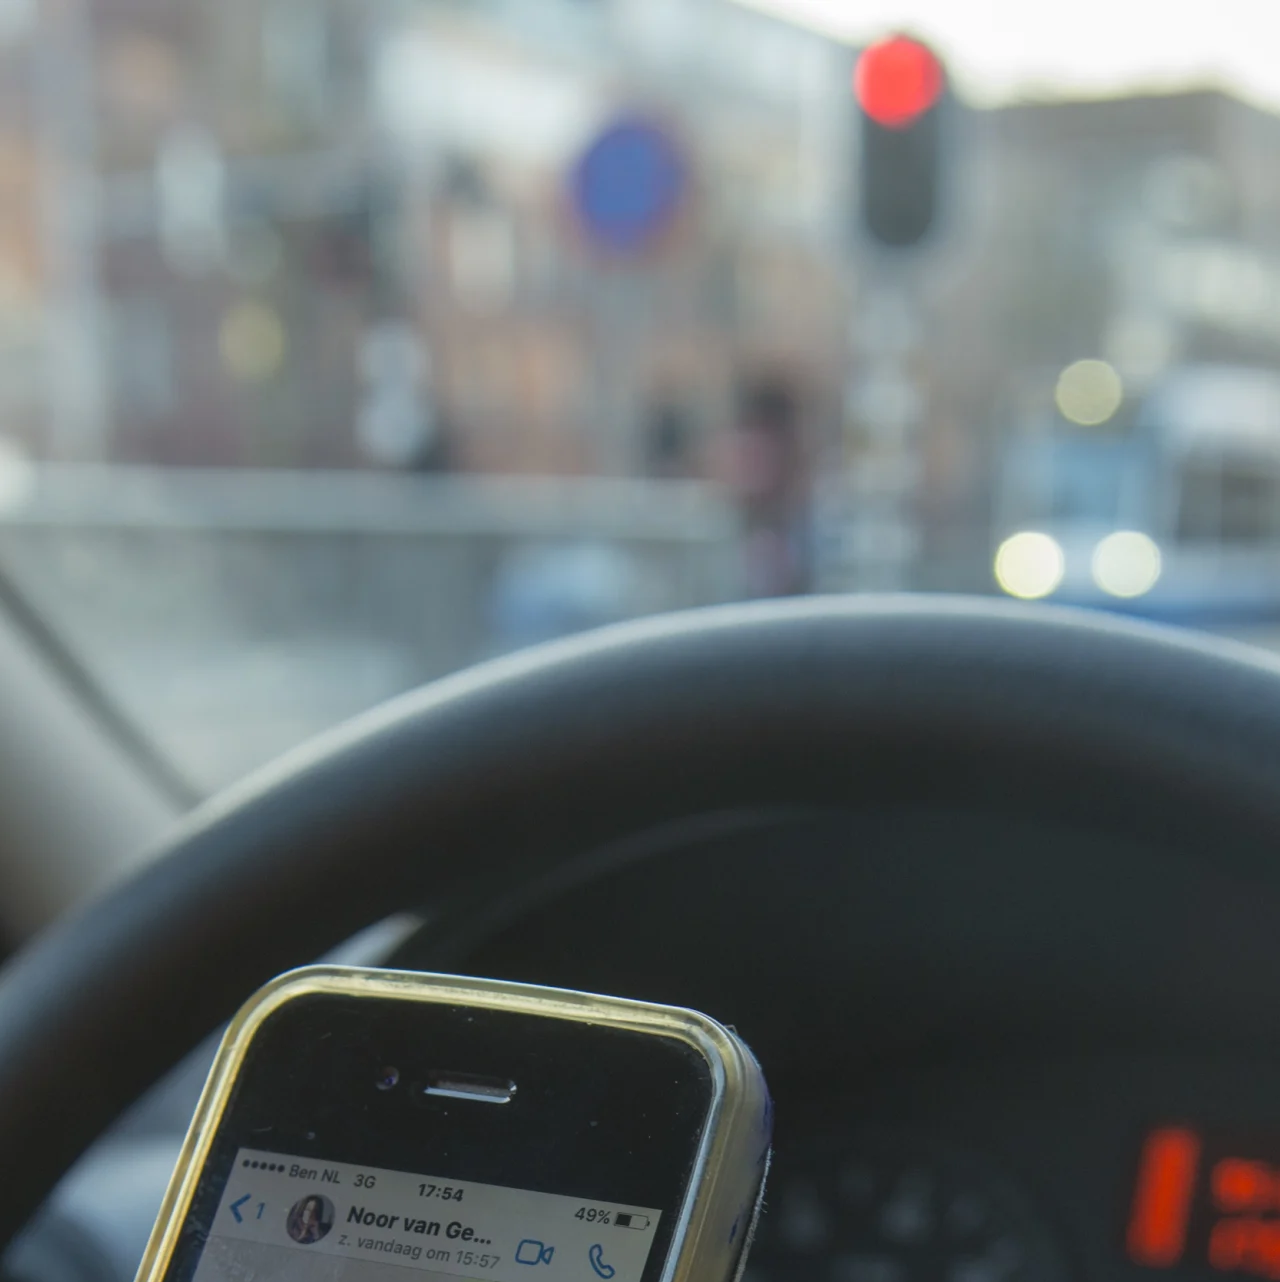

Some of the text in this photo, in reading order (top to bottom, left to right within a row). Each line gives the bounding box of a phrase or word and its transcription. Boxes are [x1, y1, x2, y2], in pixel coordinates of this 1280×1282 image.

[288, 1164, 377, 1189] Ben NL 3G
[417, 1183, 465, 1202] 17:54
[255, 1202, 266, 1220] 1
[346, 1205, 400, 1230] Noor
[404, 1219, 441, 1237] van
[574, 1207, 612, 1225] 49%
[356, 1235, 423, 1260] vandaag
[425, 1248, 450, 1263] om
[456, 1249, 501, 1270] 15:57
